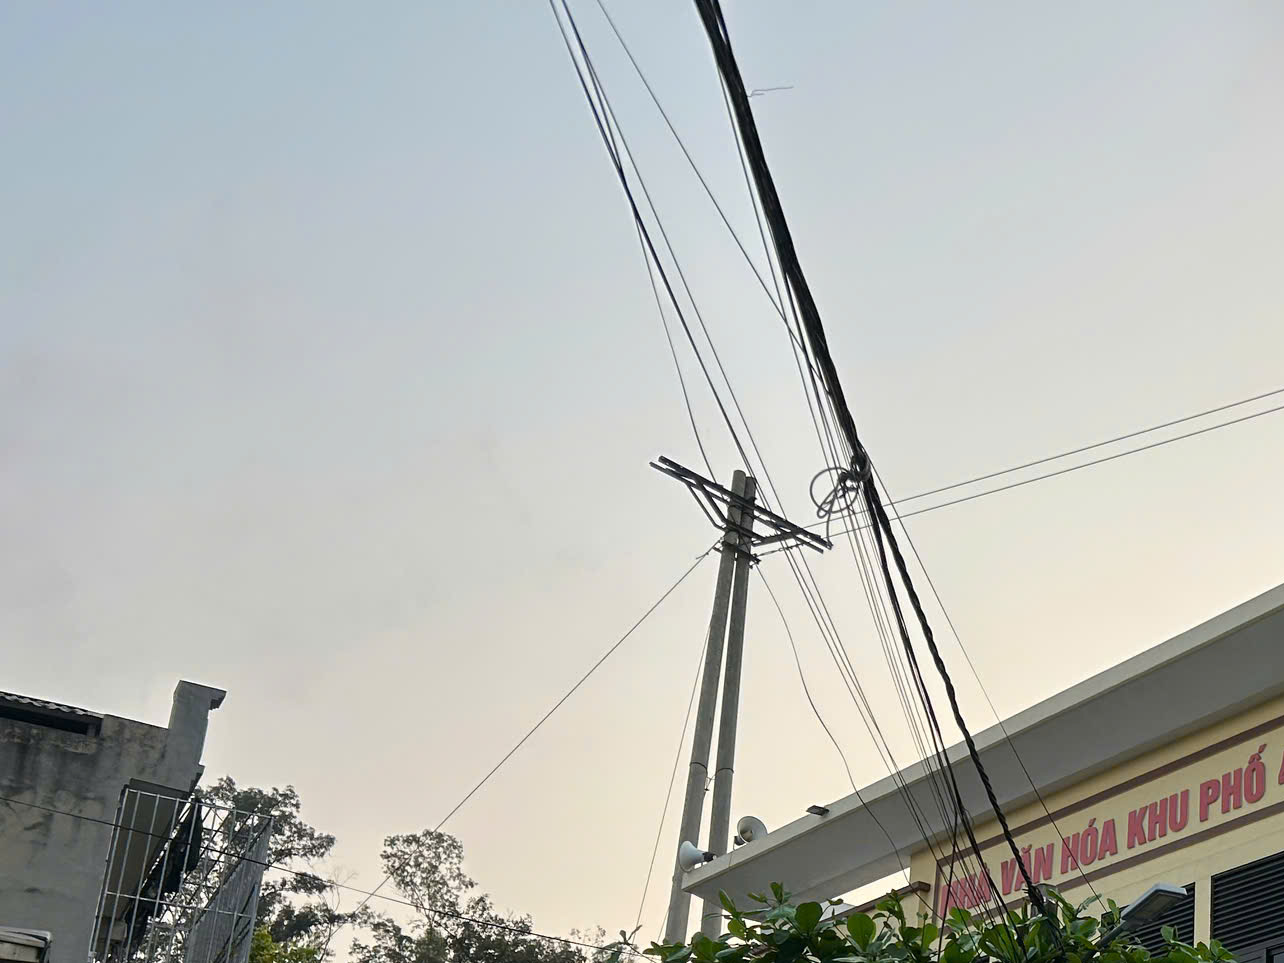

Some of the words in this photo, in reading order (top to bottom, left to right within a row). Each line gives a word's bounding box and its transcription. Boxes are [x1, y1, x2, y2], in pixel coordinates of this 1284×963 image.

[1000, 843, 1055, 896] VĂN
[1060, 817, 1118, 876] HÓA
[1126, 788, 1190, 850] KHU
[1199, 743, 1268, 823] PHỐ
